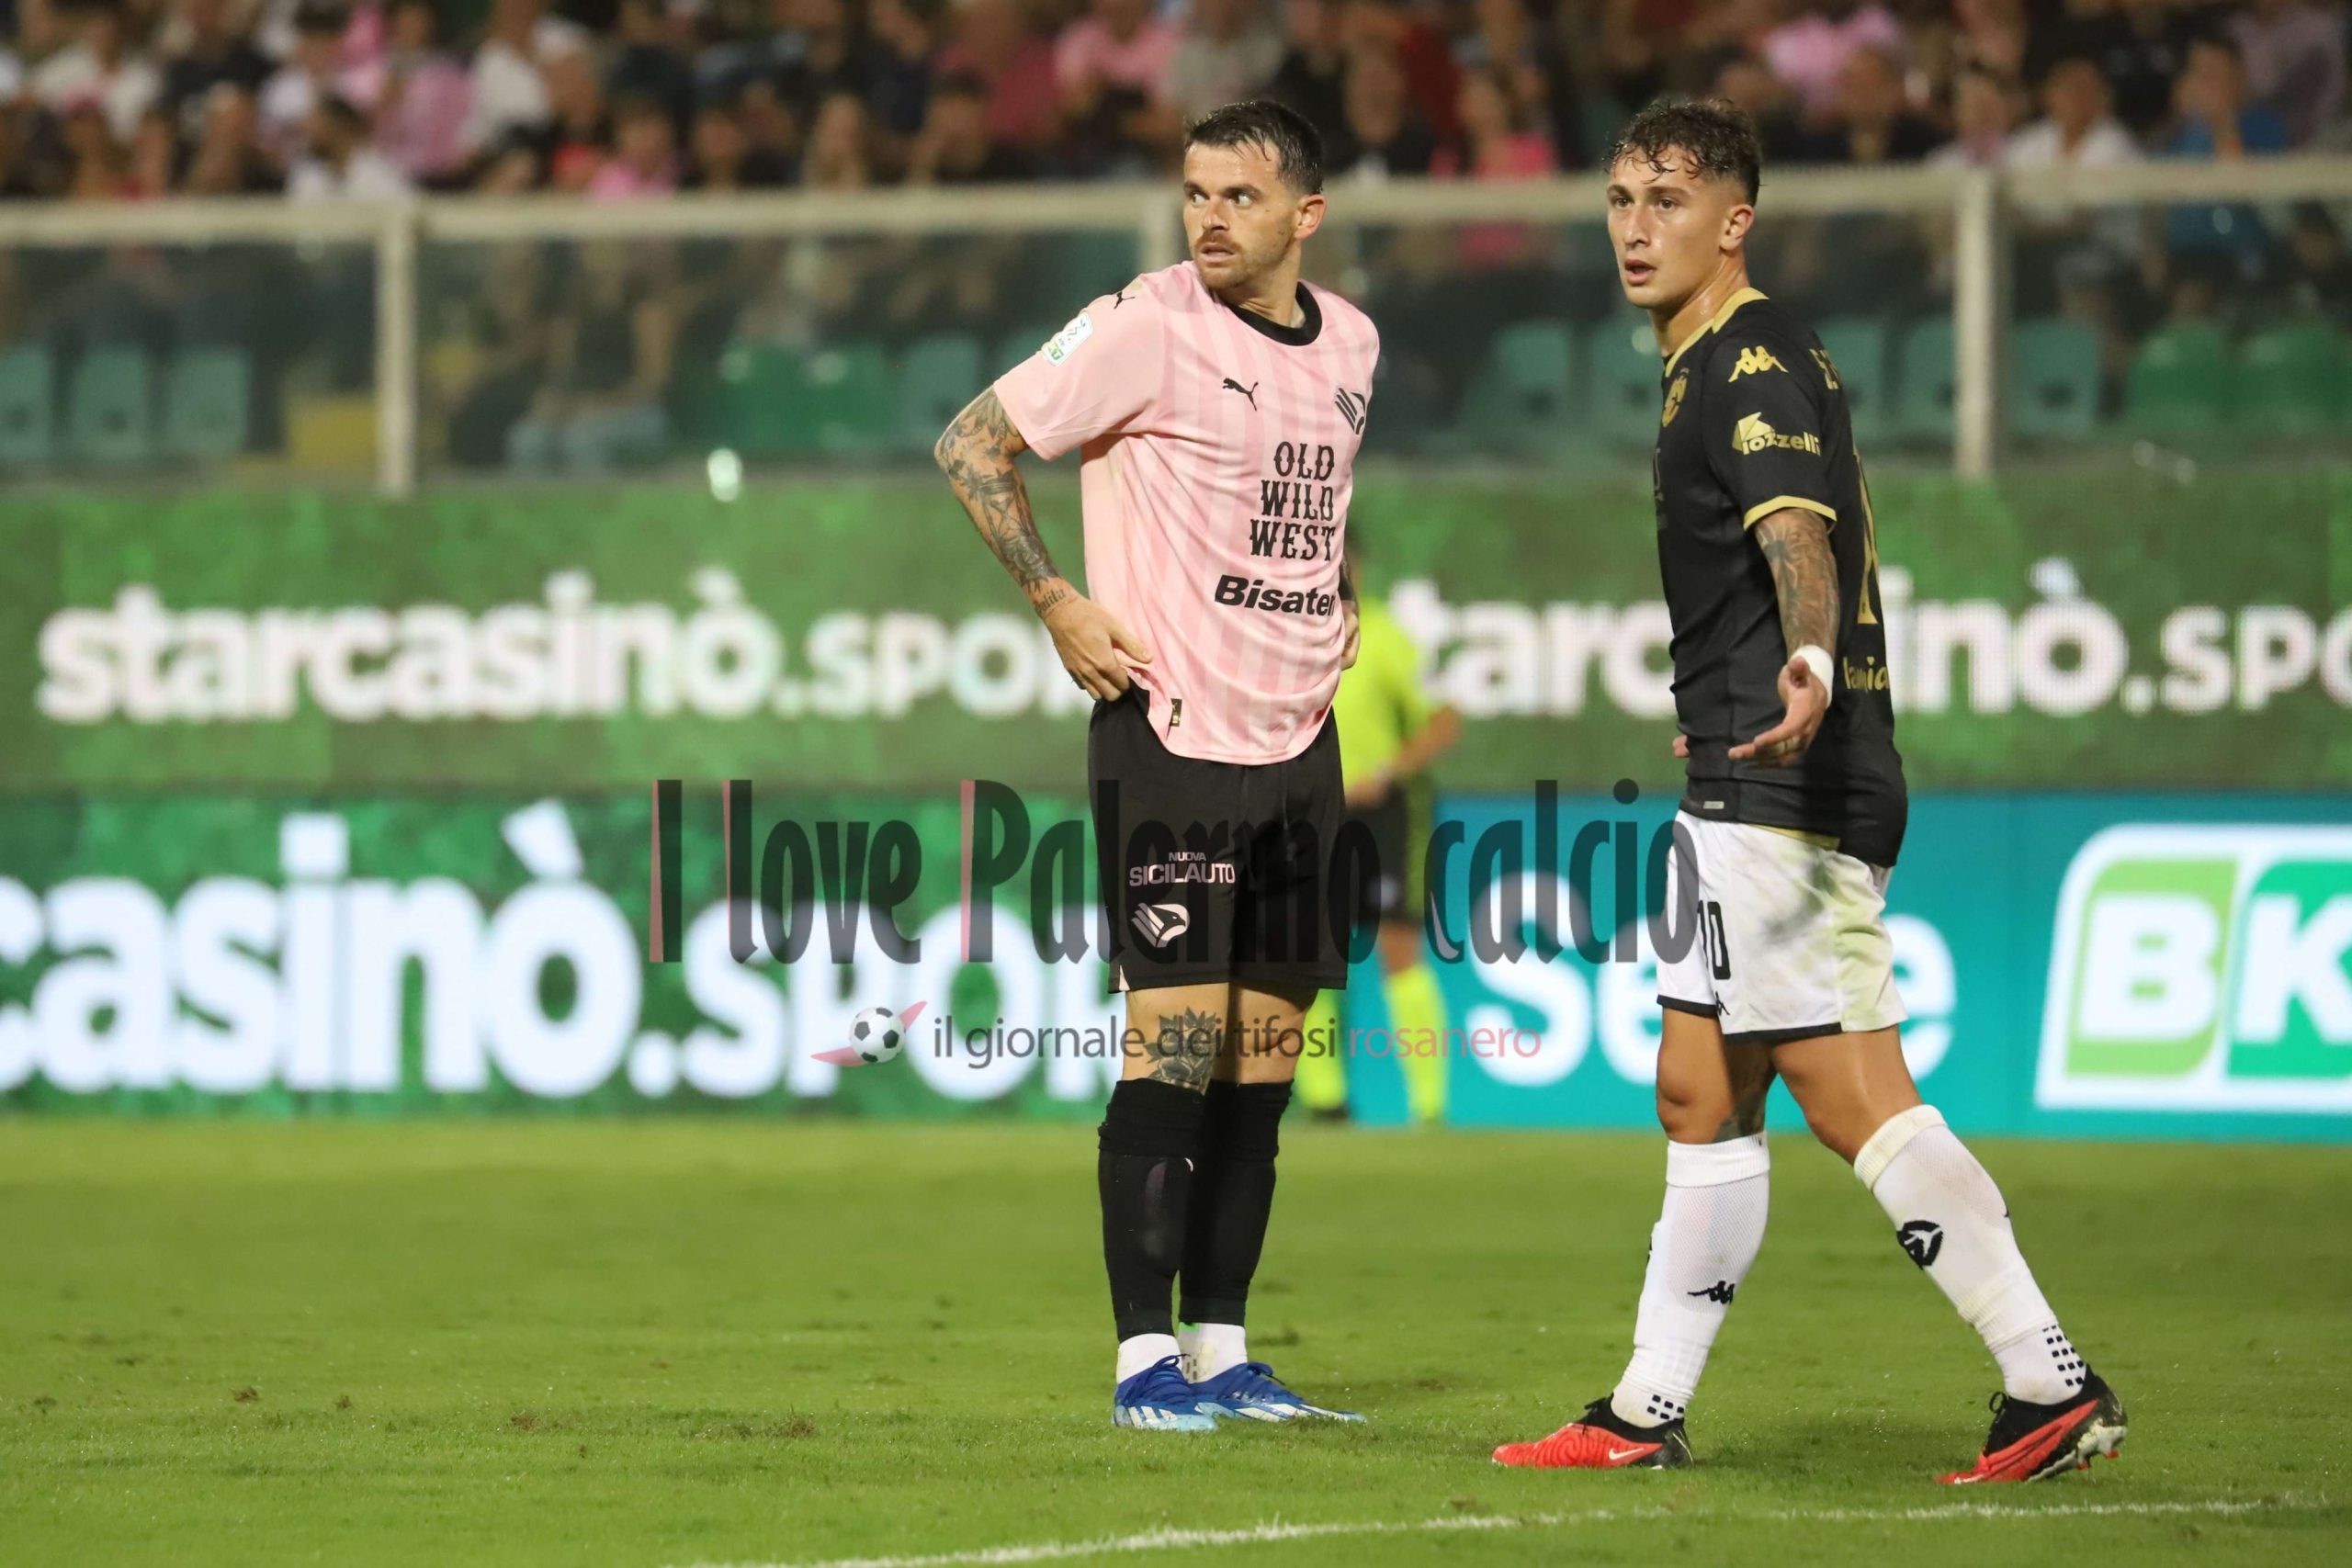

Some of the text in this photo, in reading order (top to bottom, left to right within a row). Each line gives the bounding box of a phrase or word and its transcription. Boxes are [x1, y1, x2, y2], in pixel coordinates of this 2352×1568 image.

[1274, 442, 1335, 481] OLD
[1261, 479, 1334, 521] WILD
[1250, 519, 1336, 561] WEST
[1129, 863, 1236, 886] SICILAUTO
[1168, 852, 1206, 862] NUOVA
